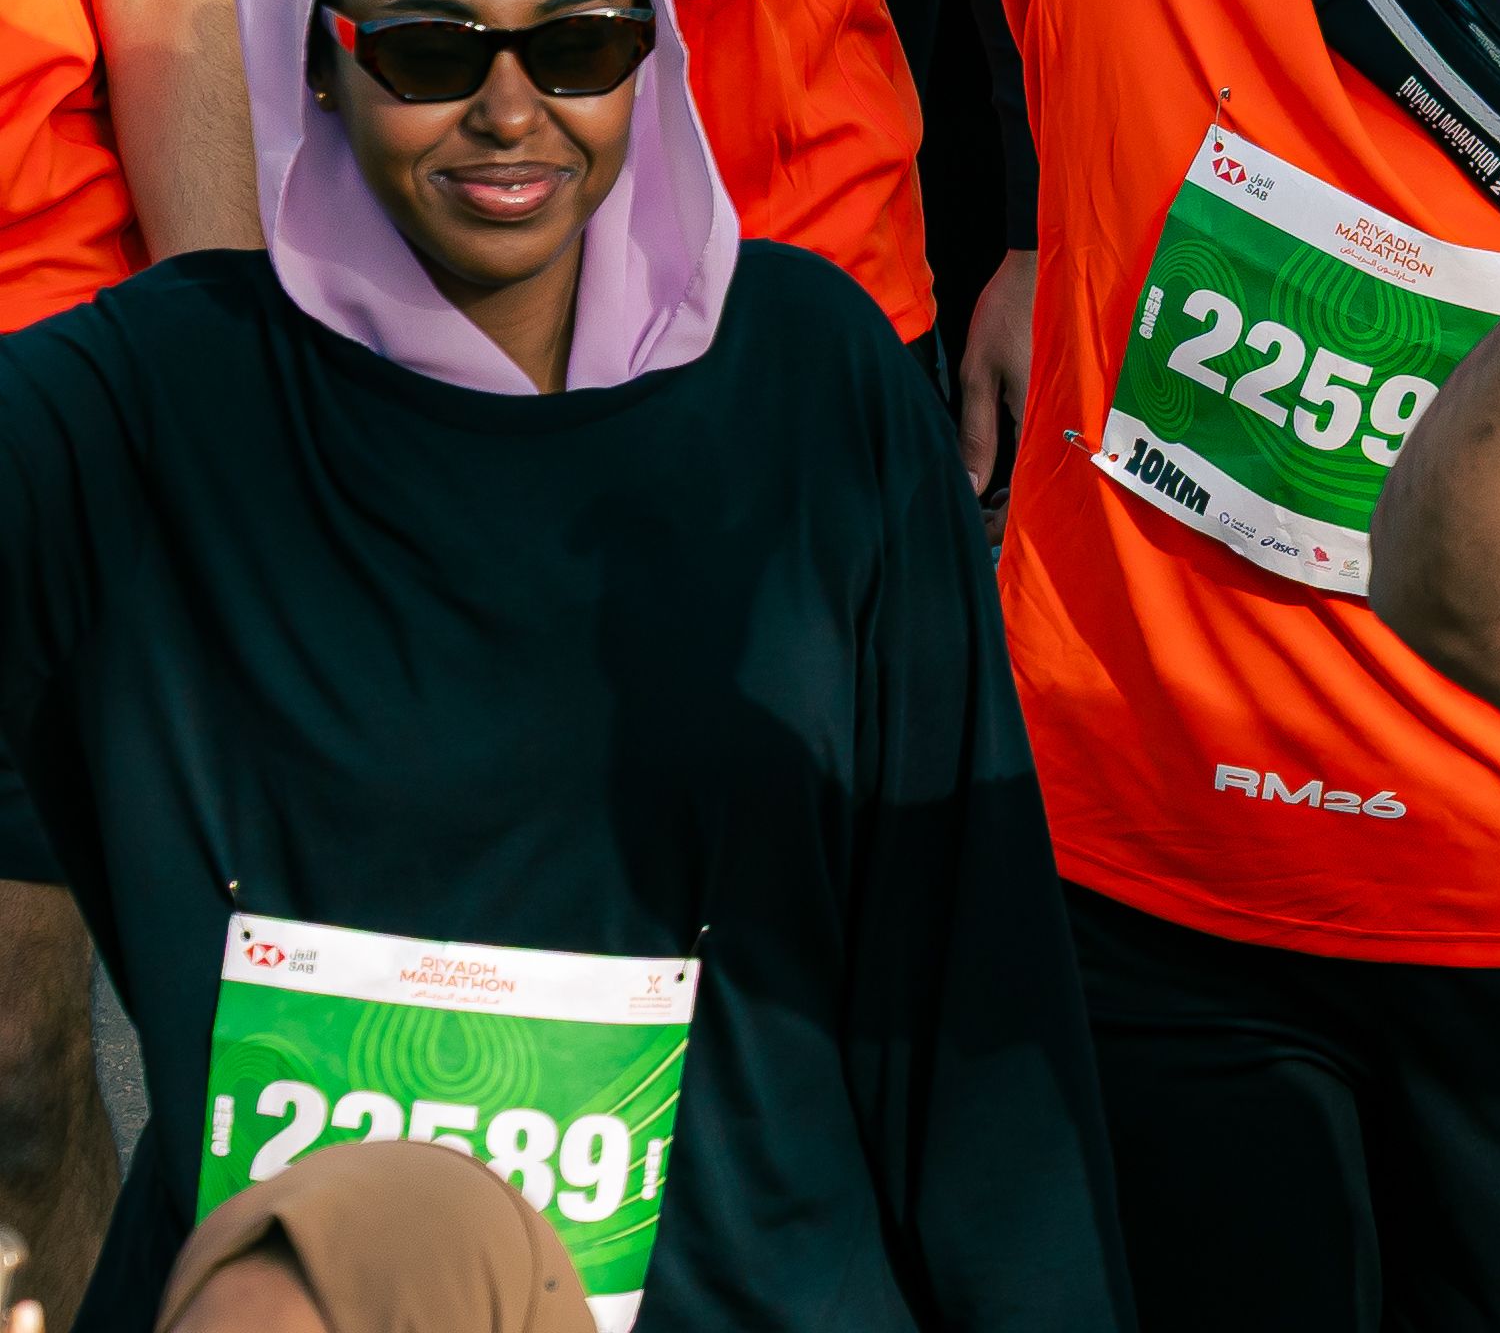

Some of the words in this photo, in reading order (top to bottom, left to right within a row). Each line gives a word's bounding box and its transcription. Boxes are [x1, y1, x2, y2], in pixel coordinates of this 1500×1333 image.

[1399, 75, 1446, 122] RIYADH
[1245, 183, 1270, 203] SAB
[1250, 171, 1276, 192] الأول
[1334, 222, 1436, 279] MARATHON
[1356, 217, 1422, 259] RIYADH
[1167, 288, 1441, 469] 2259
[1123, 437, 1212, 517] 10KM
[1272, 541, 1301, 558] asics
[1214, 763, 1407, 820] RM26
[288, 960, 315, 975] SAB
[400, 969, 516, 993] MARATHON
[420, 956, 497, 976] RIYADH
